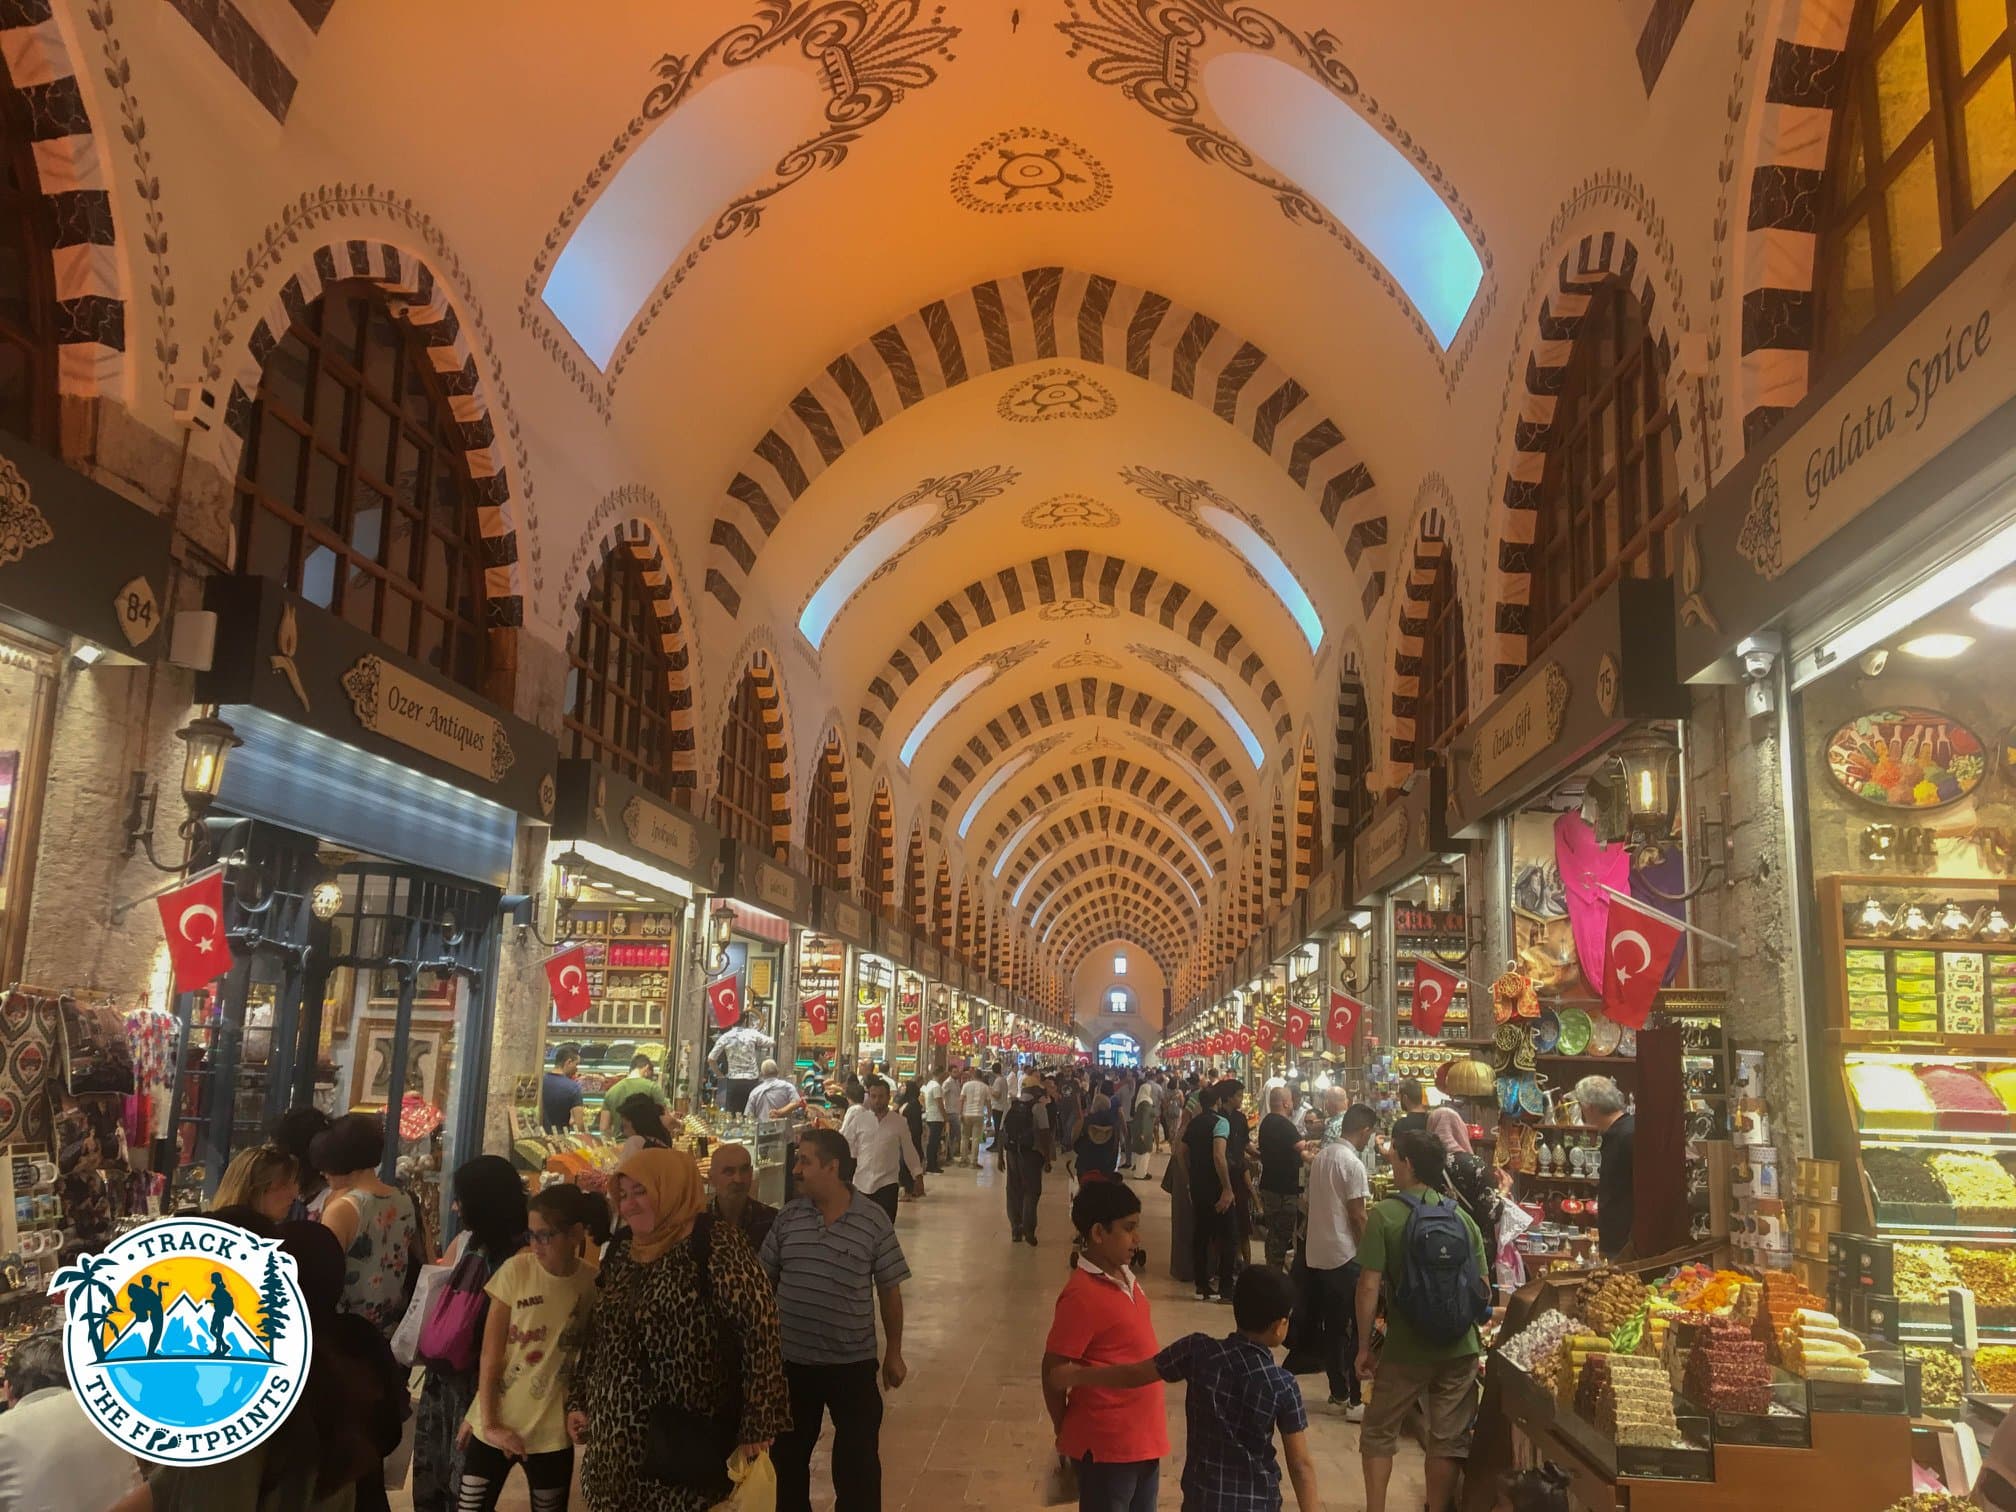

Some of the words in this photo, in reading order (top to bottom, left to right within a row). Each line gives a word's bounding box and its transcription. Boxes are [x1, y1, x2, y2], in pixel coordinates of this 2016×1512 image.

[1806, 394, 1895, 511] Galata
[1905, 310, 1992, 431] Spice
[127, 592, 151, 628] 84
[1600, 668, 1611, 702] 75
[388, 686, 423, 721] Ozer
[426, 706, 485, 751] Antiques
[1515, 702, 1531, 747] Gift
[543, 784, 554, 805] 82
